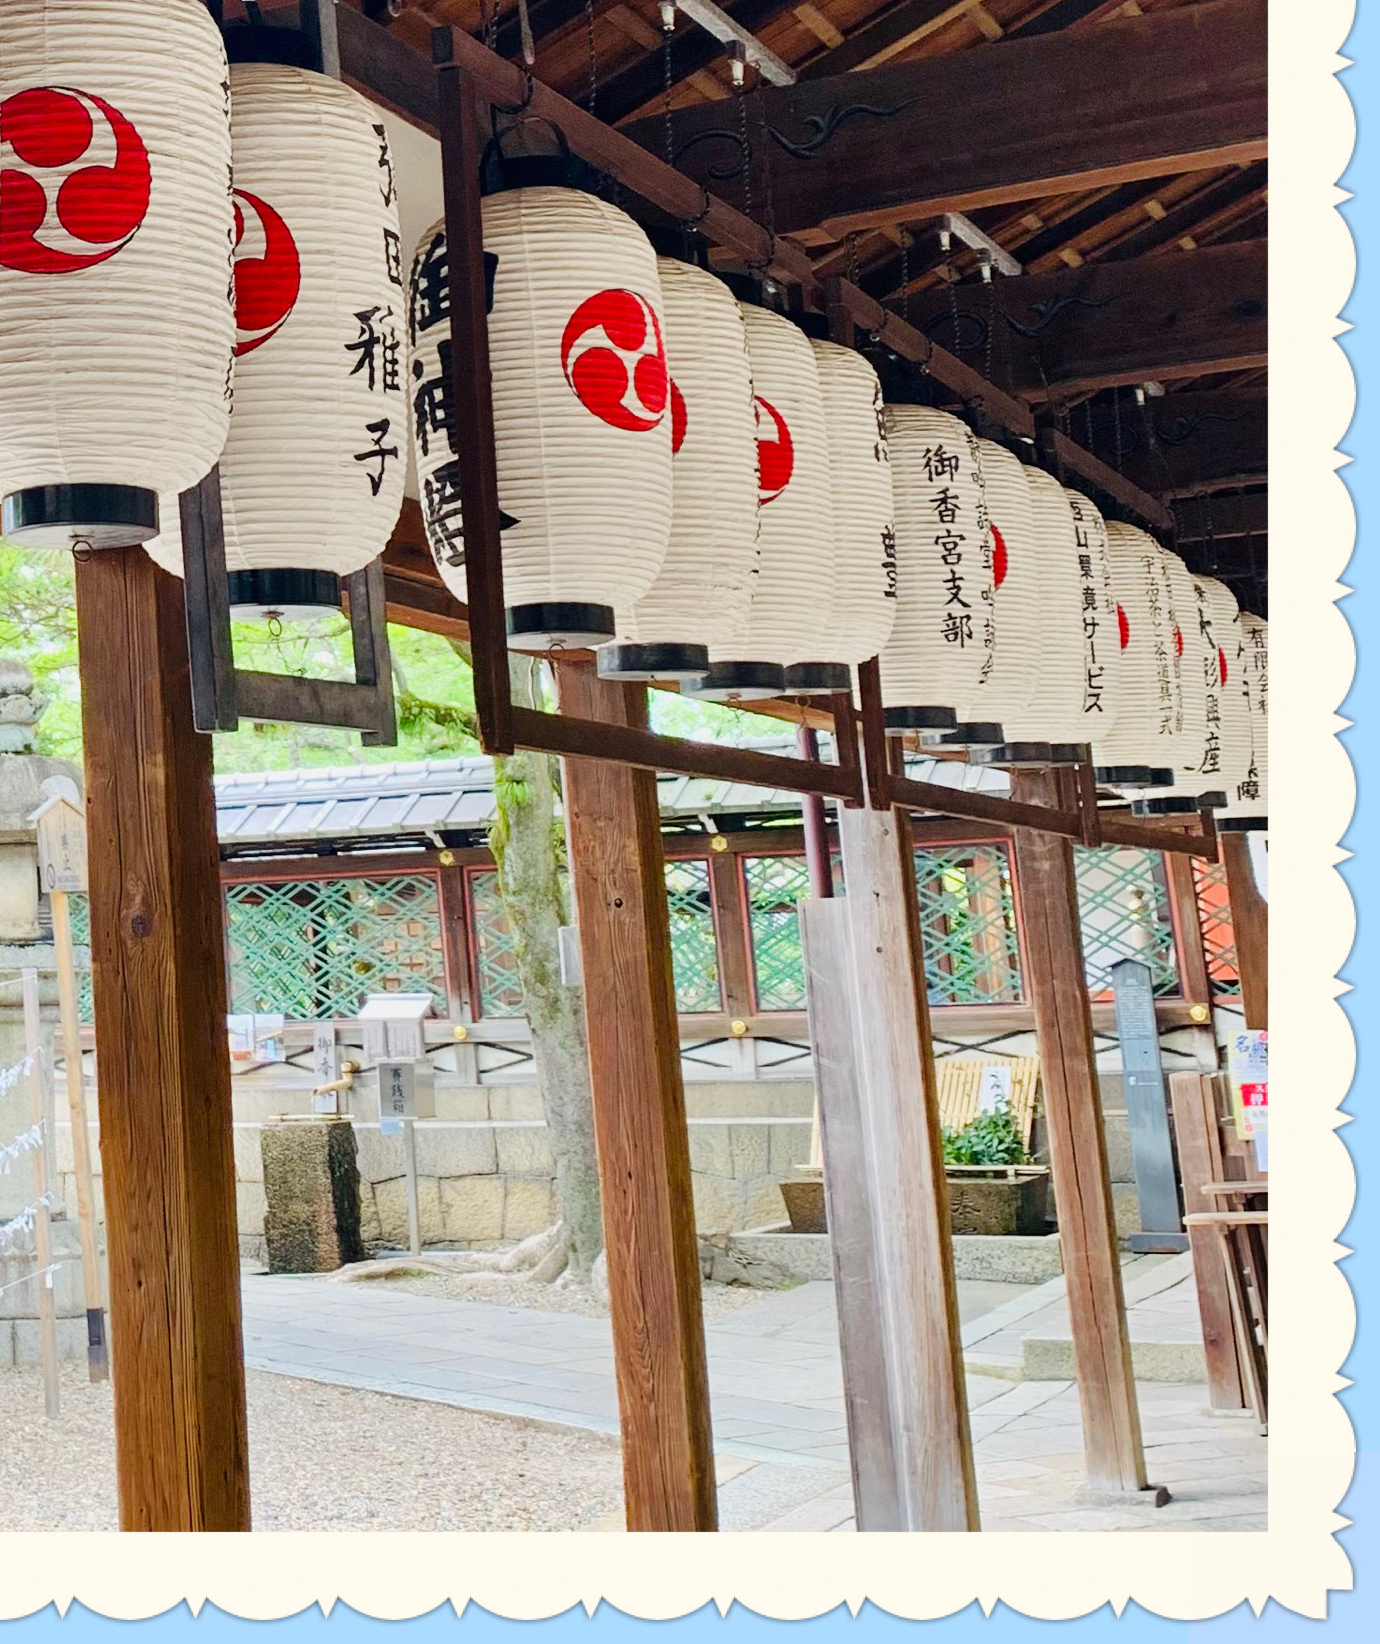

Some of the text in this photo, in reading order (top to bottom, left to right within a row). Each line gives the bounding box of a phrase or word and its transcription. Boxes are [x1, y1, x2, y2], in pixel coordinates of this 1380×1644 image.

[922, 444, 973, 648] 御香宮支部
[317, 1036, 335, 1099] 御香
